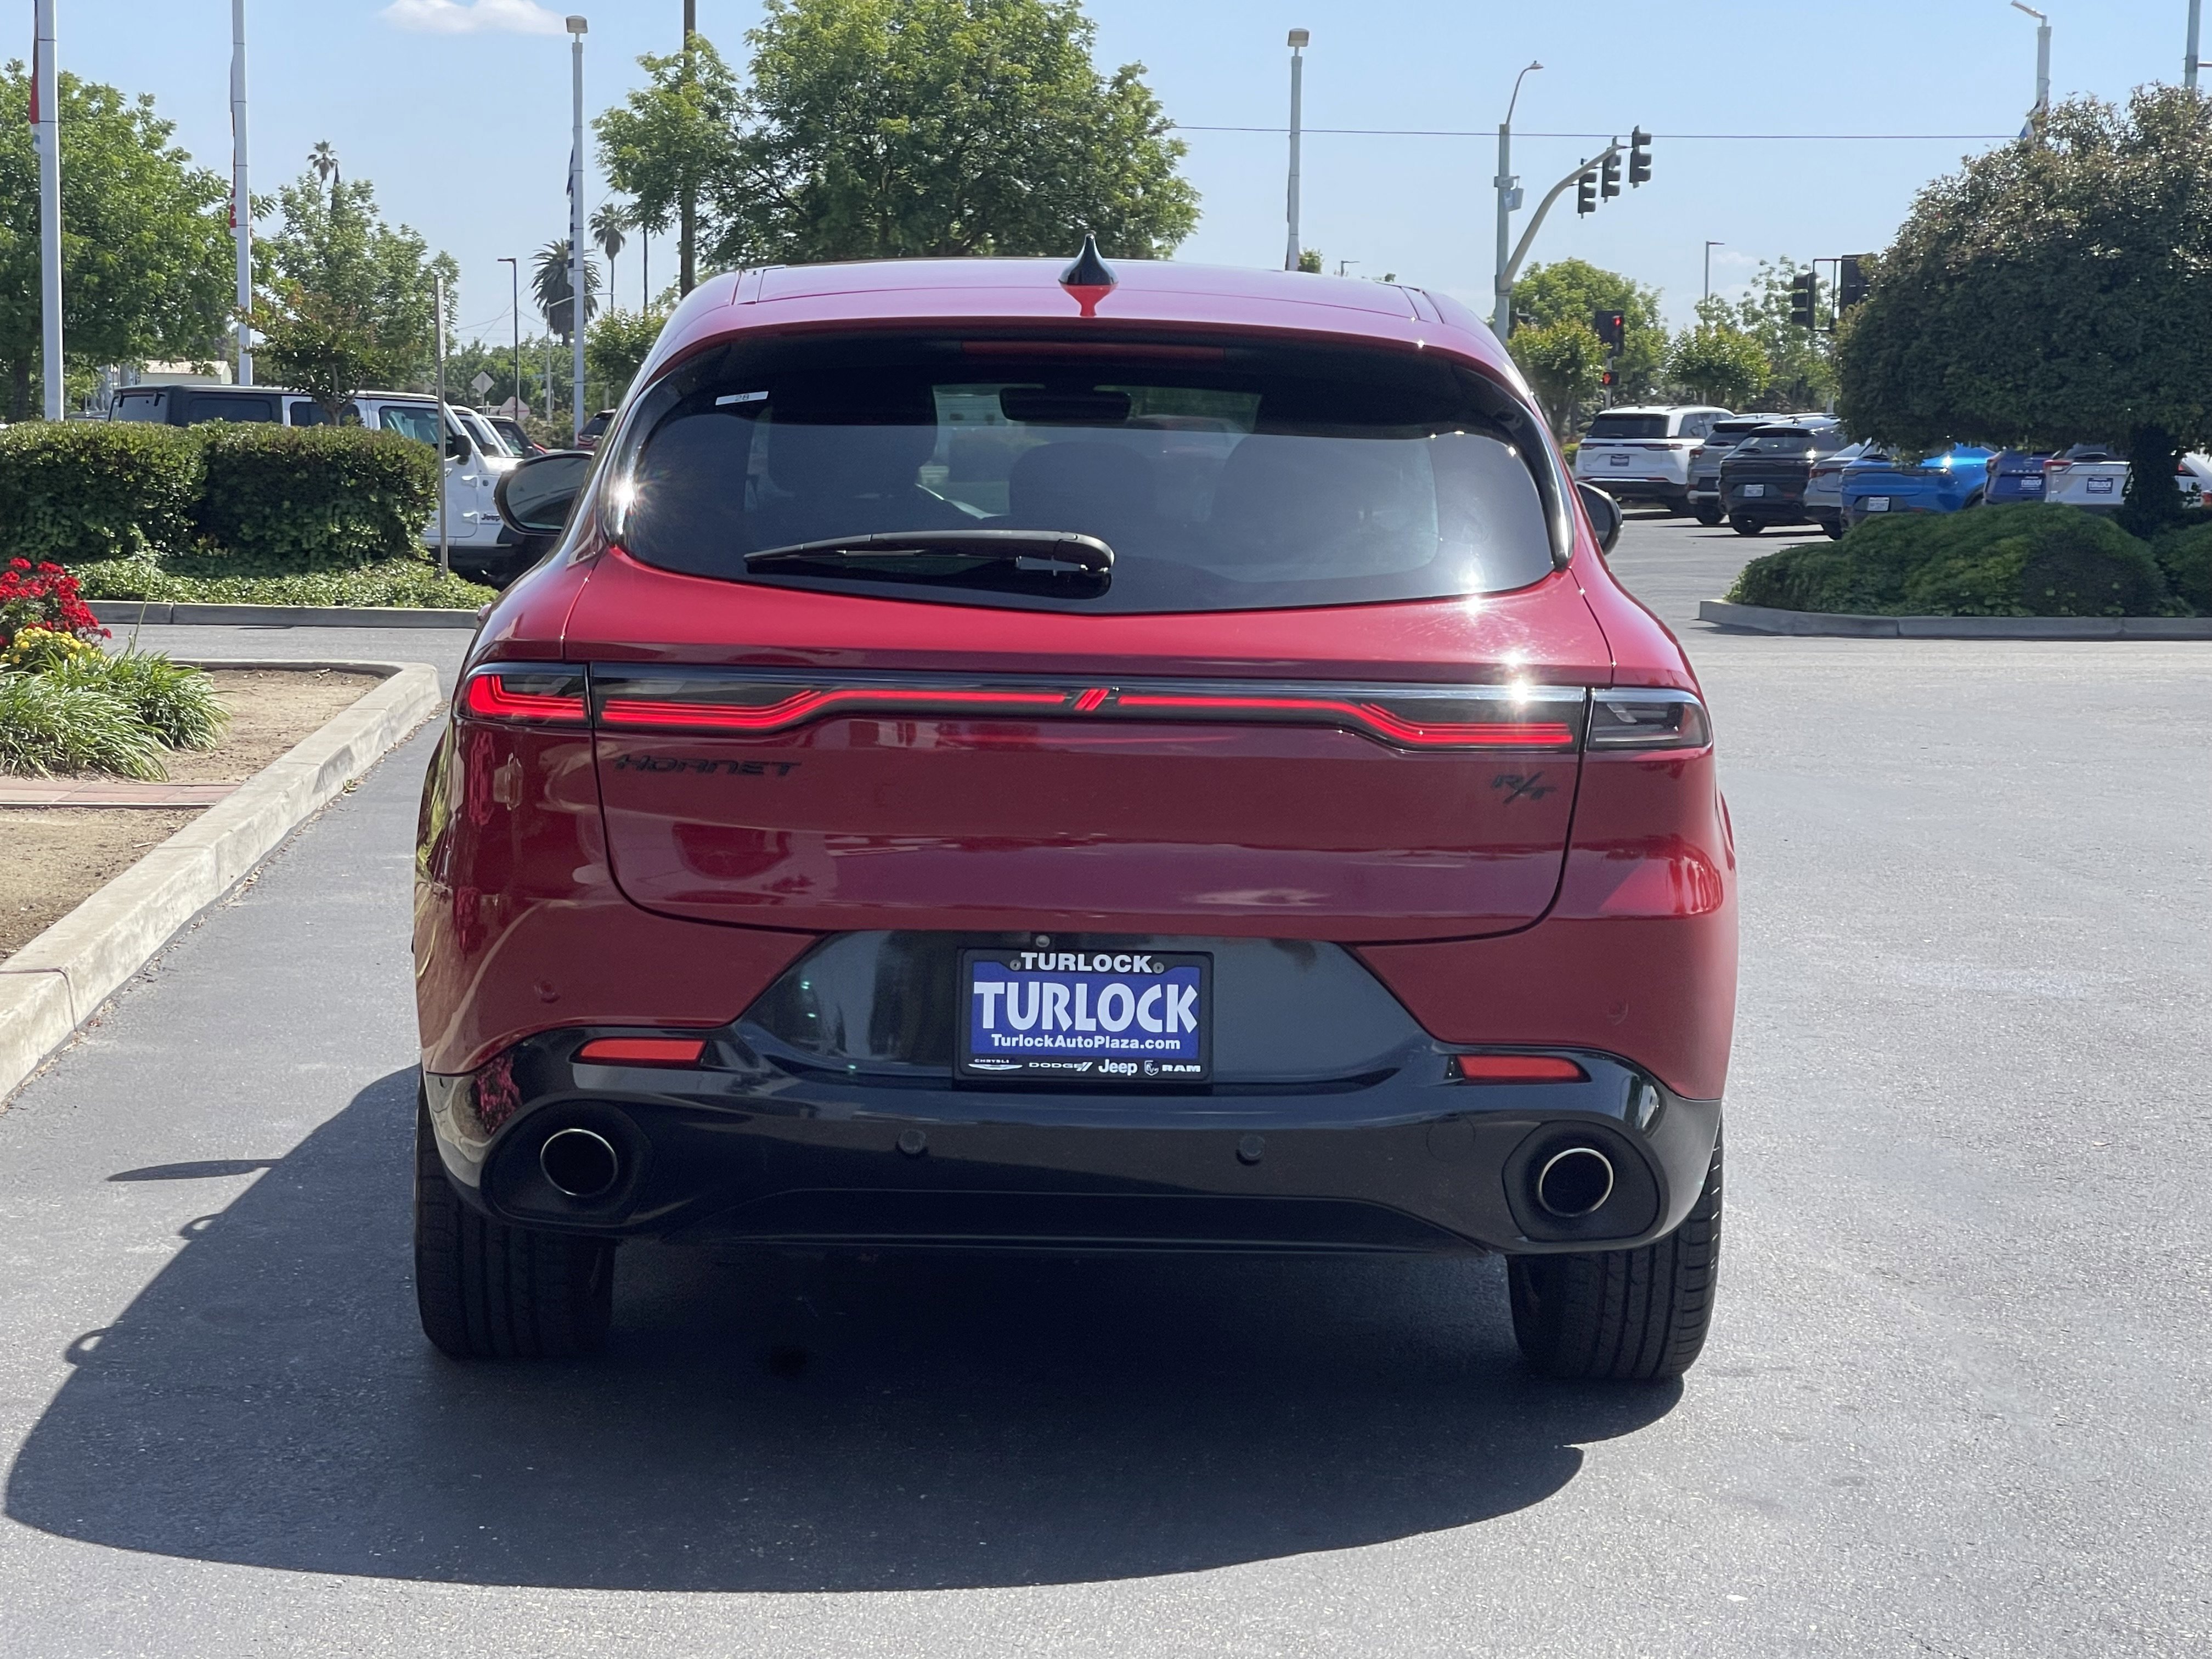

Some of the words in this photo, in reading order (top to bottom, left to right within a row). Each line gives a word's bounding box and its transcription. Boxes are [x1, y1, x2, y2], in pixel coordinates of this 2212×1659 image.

[481, 514, 500, 522] Jeep
[614, 754, 802, 777] HORNET
[1020, 952, 1152, 973] TURLOCK
[974, 981, 1198, 1034] TURLOCK
[991, 1034, 1181, 1050] TurlockAutoPlaza.com
[1098, 1059, 1138, 1076] Jeep
[1162, 1064, 1201, 1073] RAM
